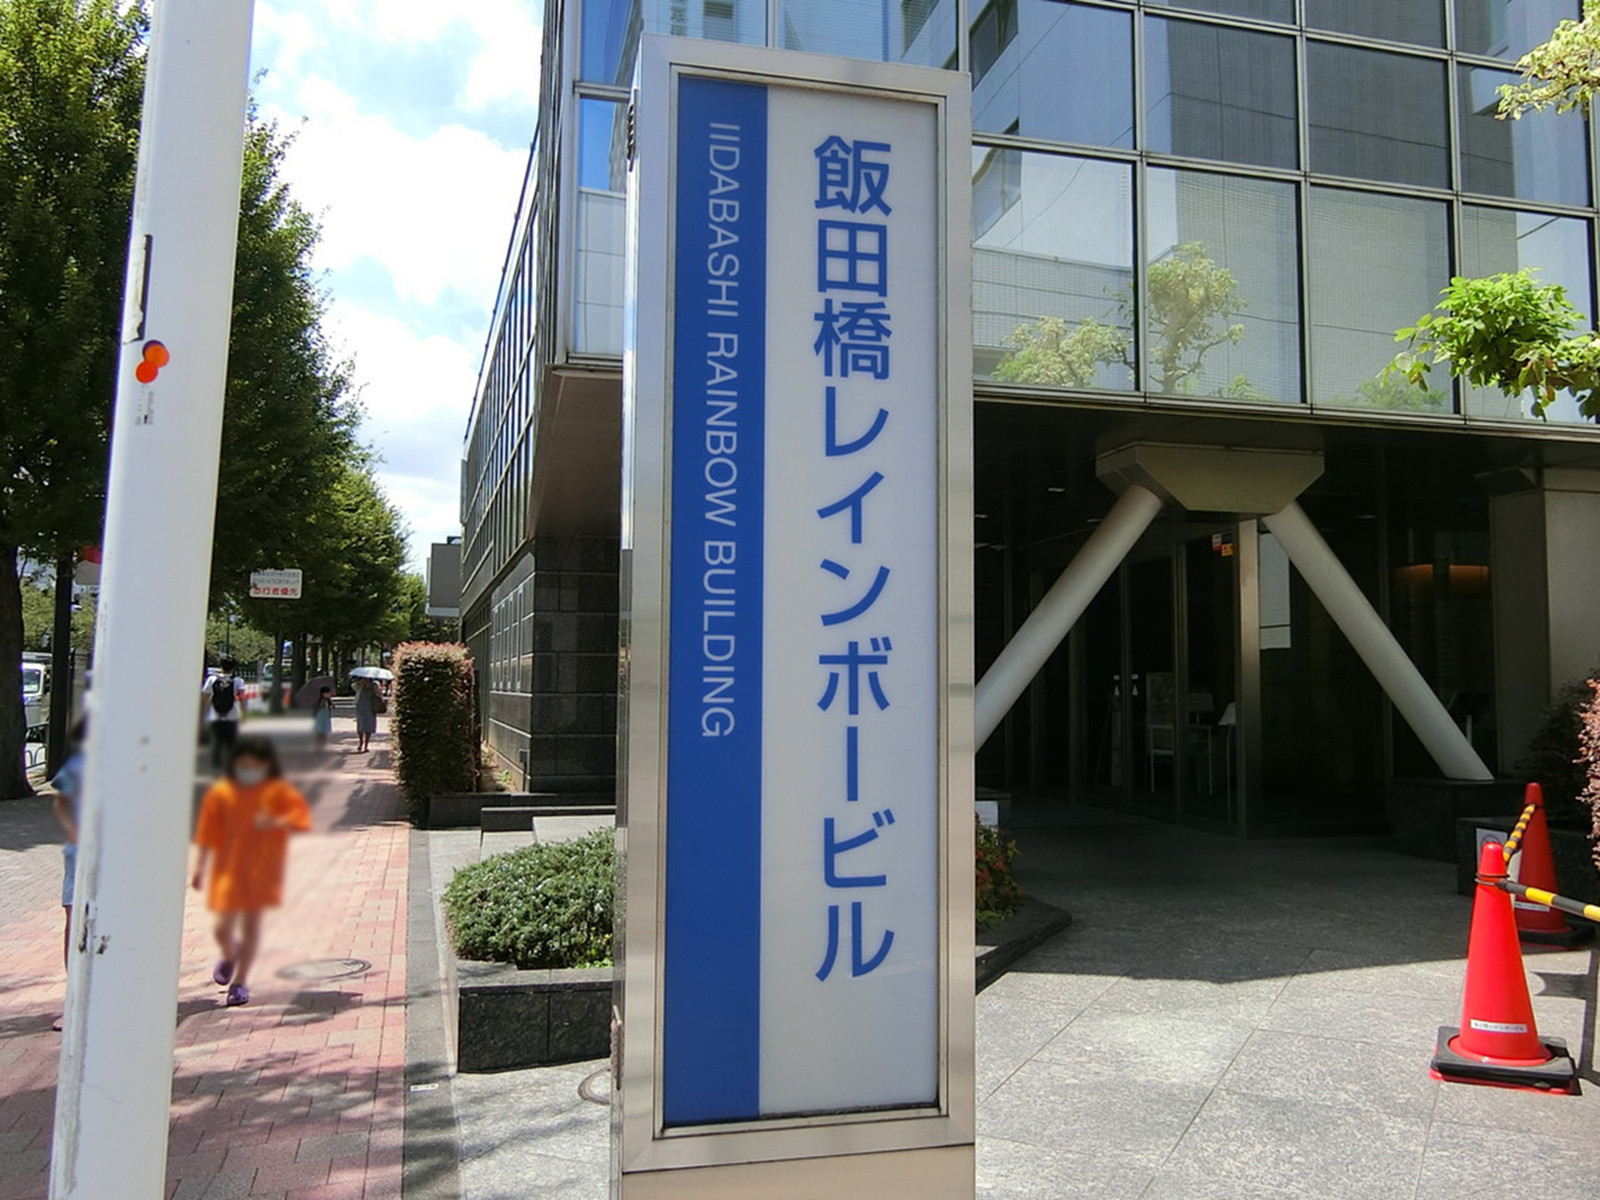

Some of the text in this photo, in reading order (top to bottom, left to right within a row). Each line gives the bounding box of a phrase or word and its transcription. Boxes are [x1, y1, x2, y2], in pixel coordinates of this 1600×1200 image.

[702, 122, 740, 737] IIDABASHI RAINBOW BUILDING
[813, 134, 895, 981] 飯田橋レインボービル
